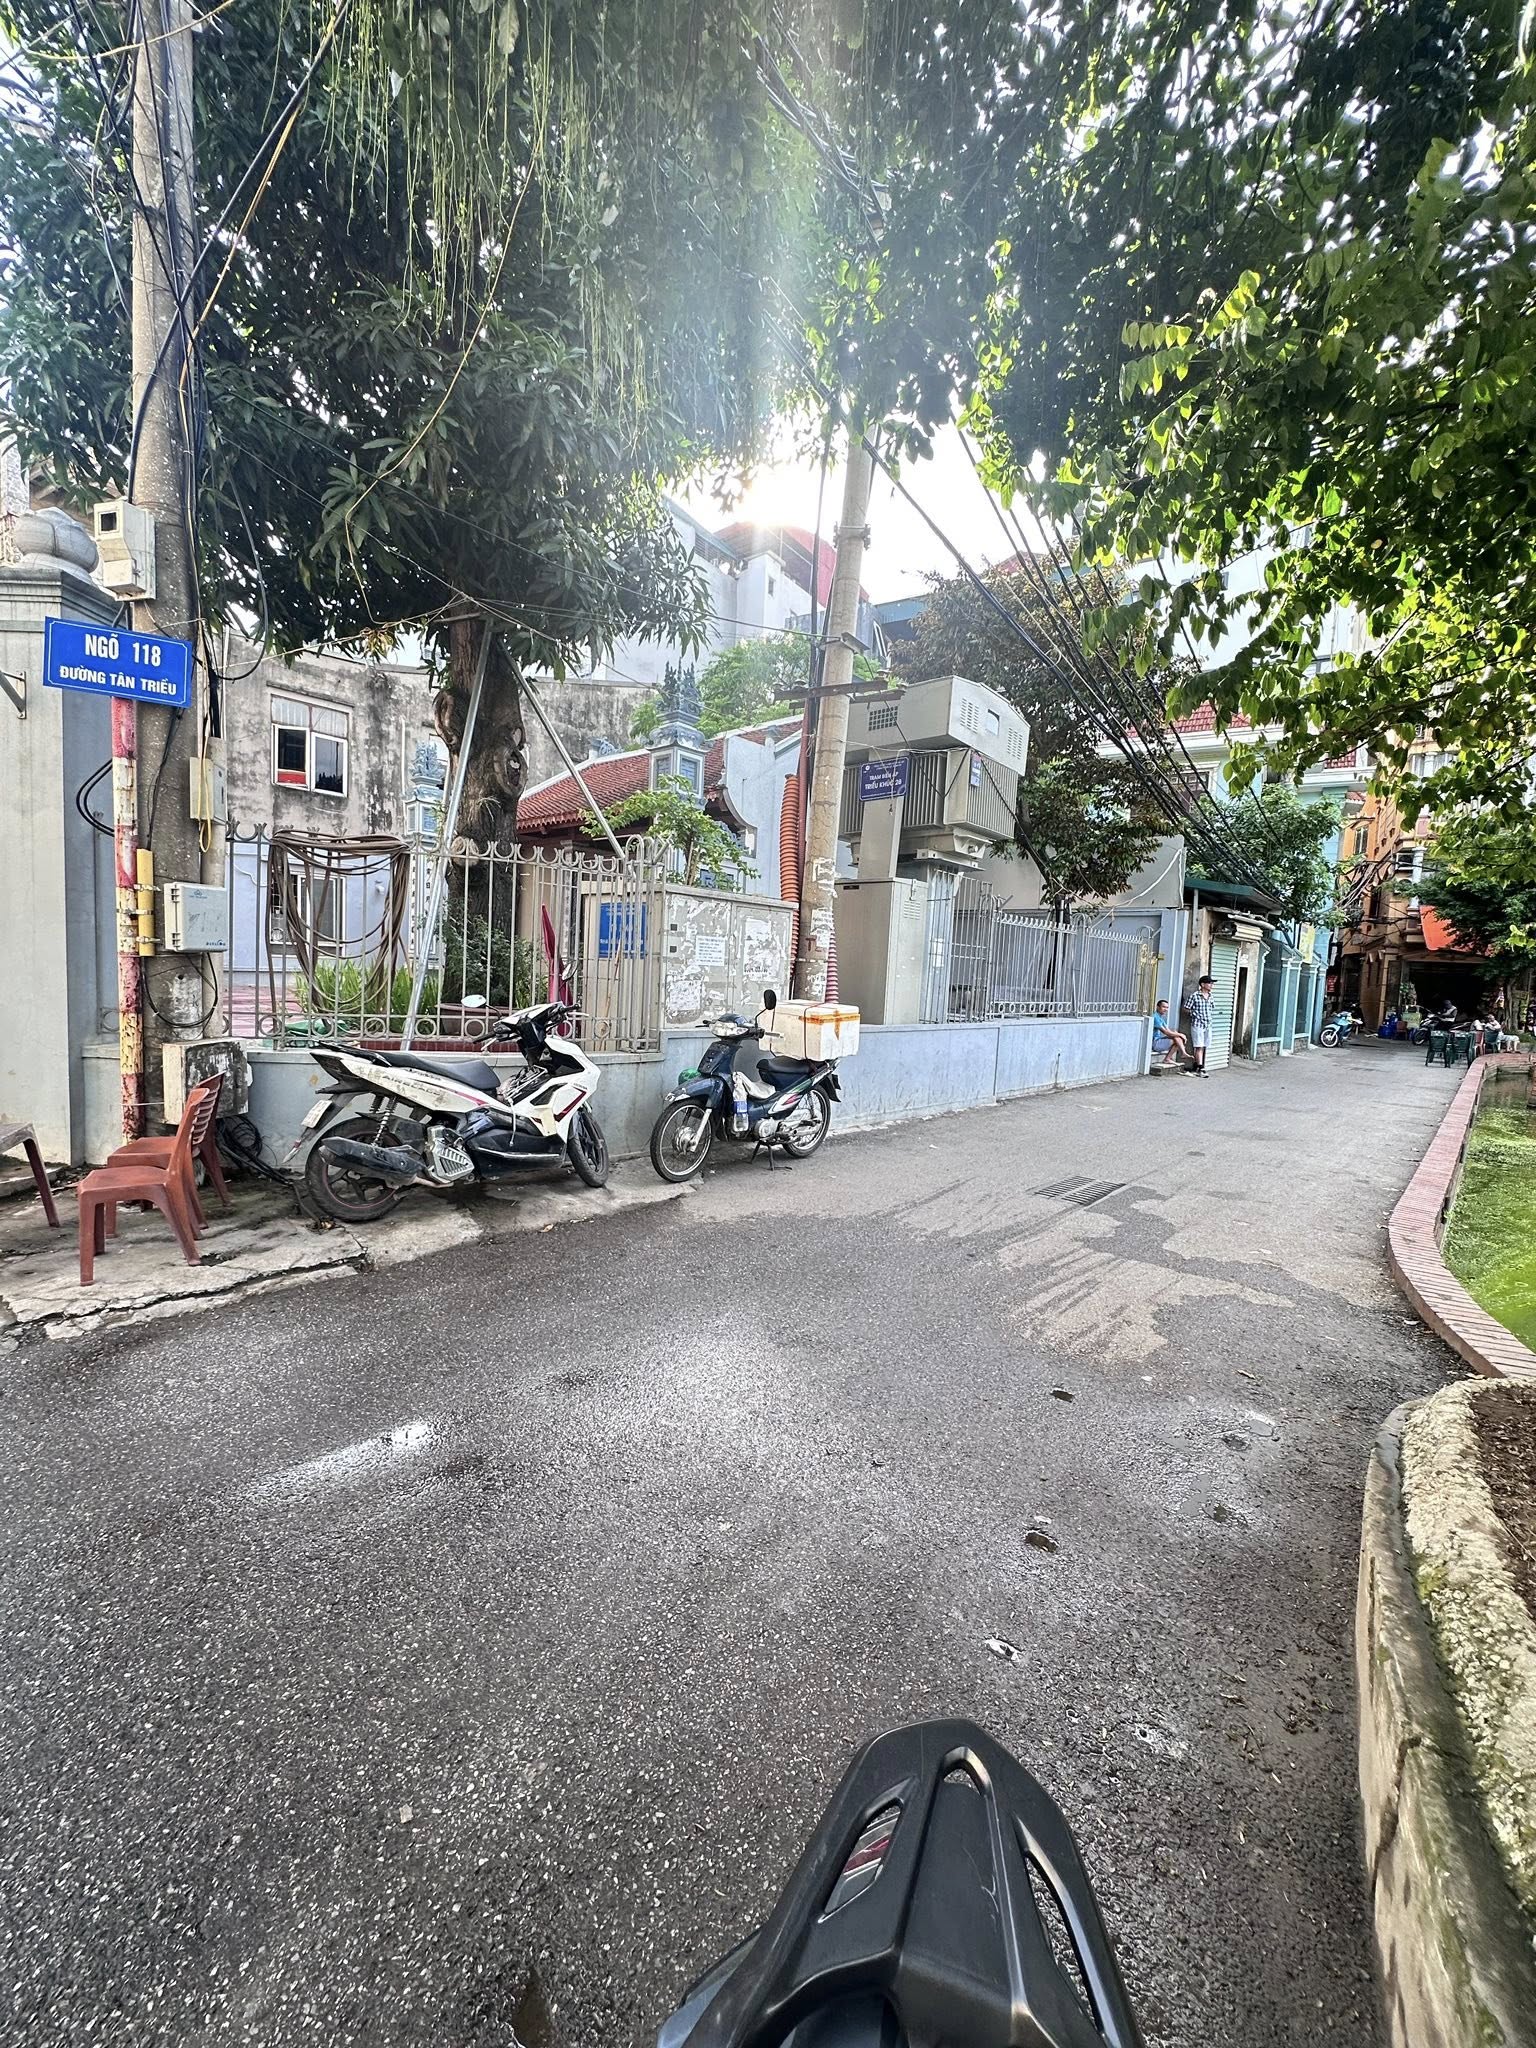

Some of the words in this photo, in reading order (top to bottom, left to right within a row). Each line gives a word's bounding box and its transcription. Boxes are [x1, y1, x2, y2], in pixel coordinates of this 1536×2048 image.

[84, 633, 119, 660] NGÕ
[132, 642, 161, 667] 118
[60, 665, 106, 684] ĐƯỜNG
[109, 672, 135, 689] TÂN
[140, 678, 177, 695] TRIỀU
